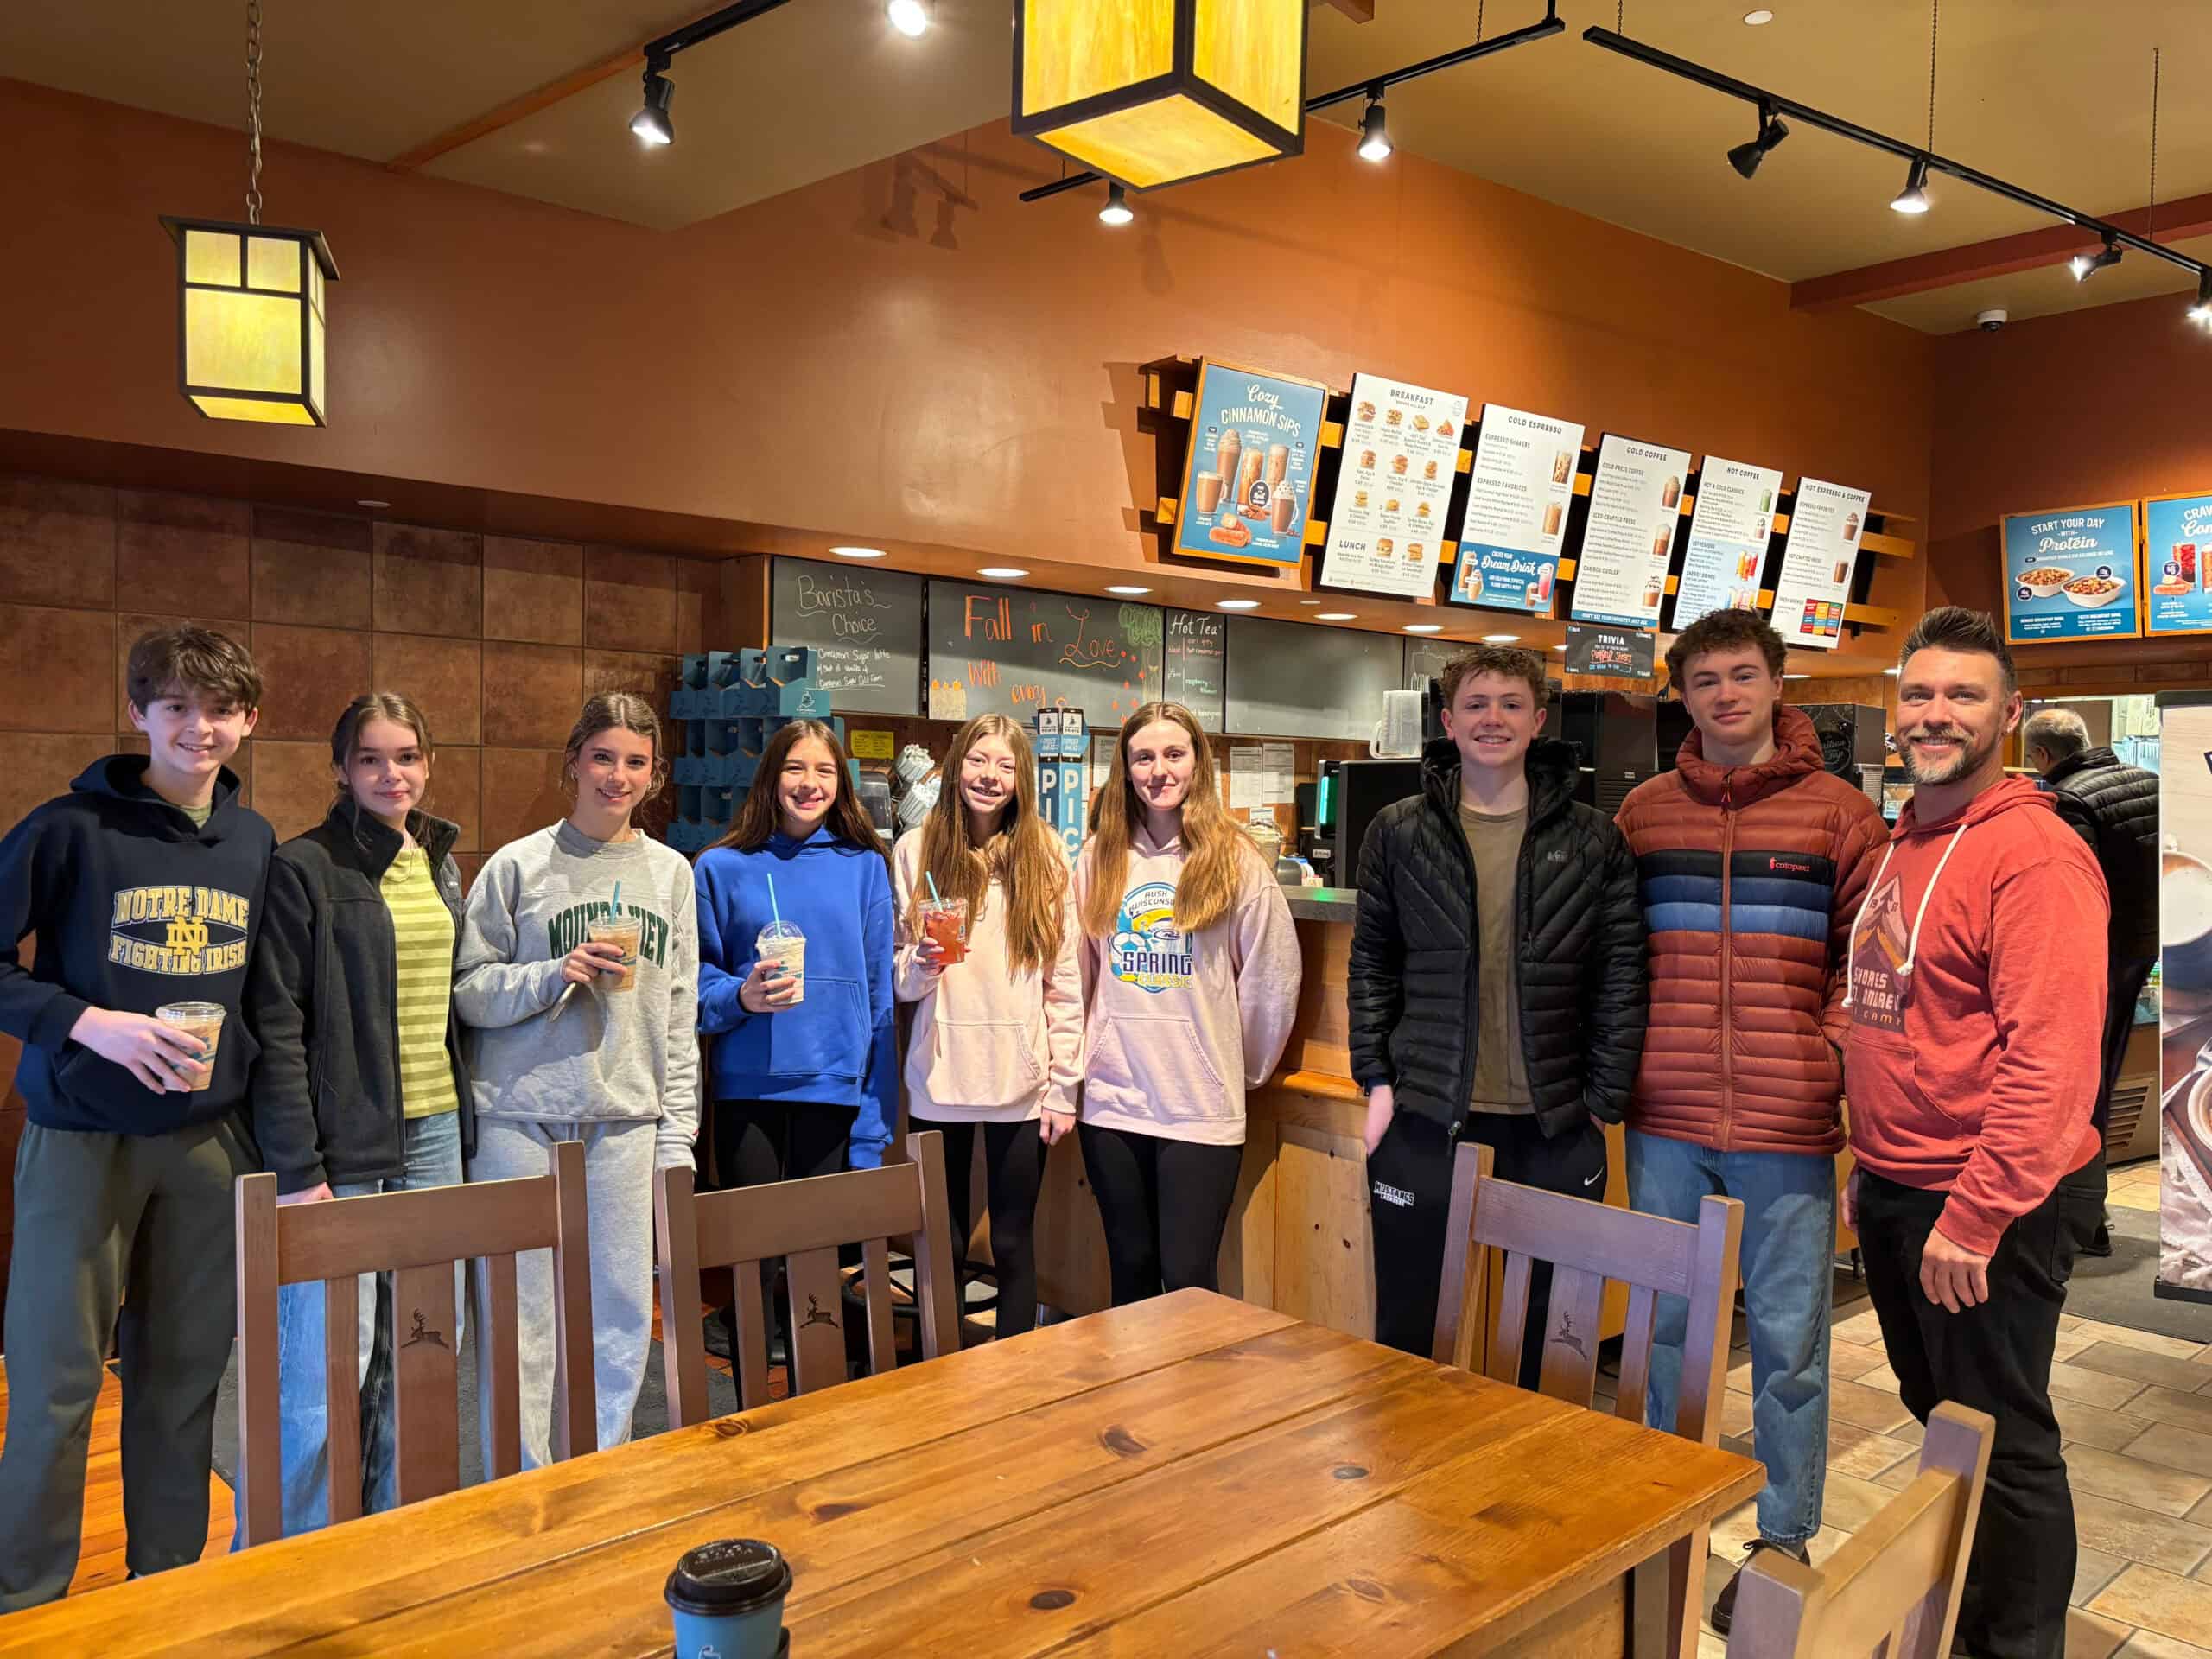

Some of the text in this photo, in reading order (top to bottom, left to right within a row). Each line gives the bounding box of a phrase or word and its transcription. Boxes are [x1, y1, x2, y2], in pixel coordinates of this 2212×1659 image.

[1247, 384, 1284, 410] Cozy
[1389, 389, 1434, 405] BREAKFAST
[1221, 407, 1277, 427] CINNAMON
[1277, 415, 1301, 437] SIPS
[1508, 416, 1562, 435] COLD ESPRESSO
[1485, 433, 1530, 448] ESPRESSO SHAKERS
[1626, 447, 1667, 461] COLD COFFEE
[1477, 477, 1527, 492] ESPRESSO FAVORITES
[1739, 469, 1760, 480] COFFEE
[1817, 486, 1841, 497] ESPRESSO
[1846, 493, 1865, 503] COFFEE
[2031, 518, 2105, 535] START YOUR DAY
[1338, 540, 1366, 550] LUNCH
[2039, 536, 2098, 553] Protein
[1481, 555, 1536, 576] Dream Drink
[796, 574, 875, 608] Barista's
[832, 611, 877, 636] Choice
[964, 594, 1116, 660] Fall in Love
[1169, 614, 1217, 636] Hot Tea
[1598, 634, 1624, 645] TRIVIA
[968, 659, 1002, 688] With
[113, 886, 249, 933] NOTRE DAME
[166, 916, 208, 956] ND
[109, 933, 247, 975] FIGHTING IRISH
[1122, 951, 1192, 976] SPRING
[1853, 966, 1889, 989] SHORES
[1374, 1180, 1414, 1206] MUSTANGS
